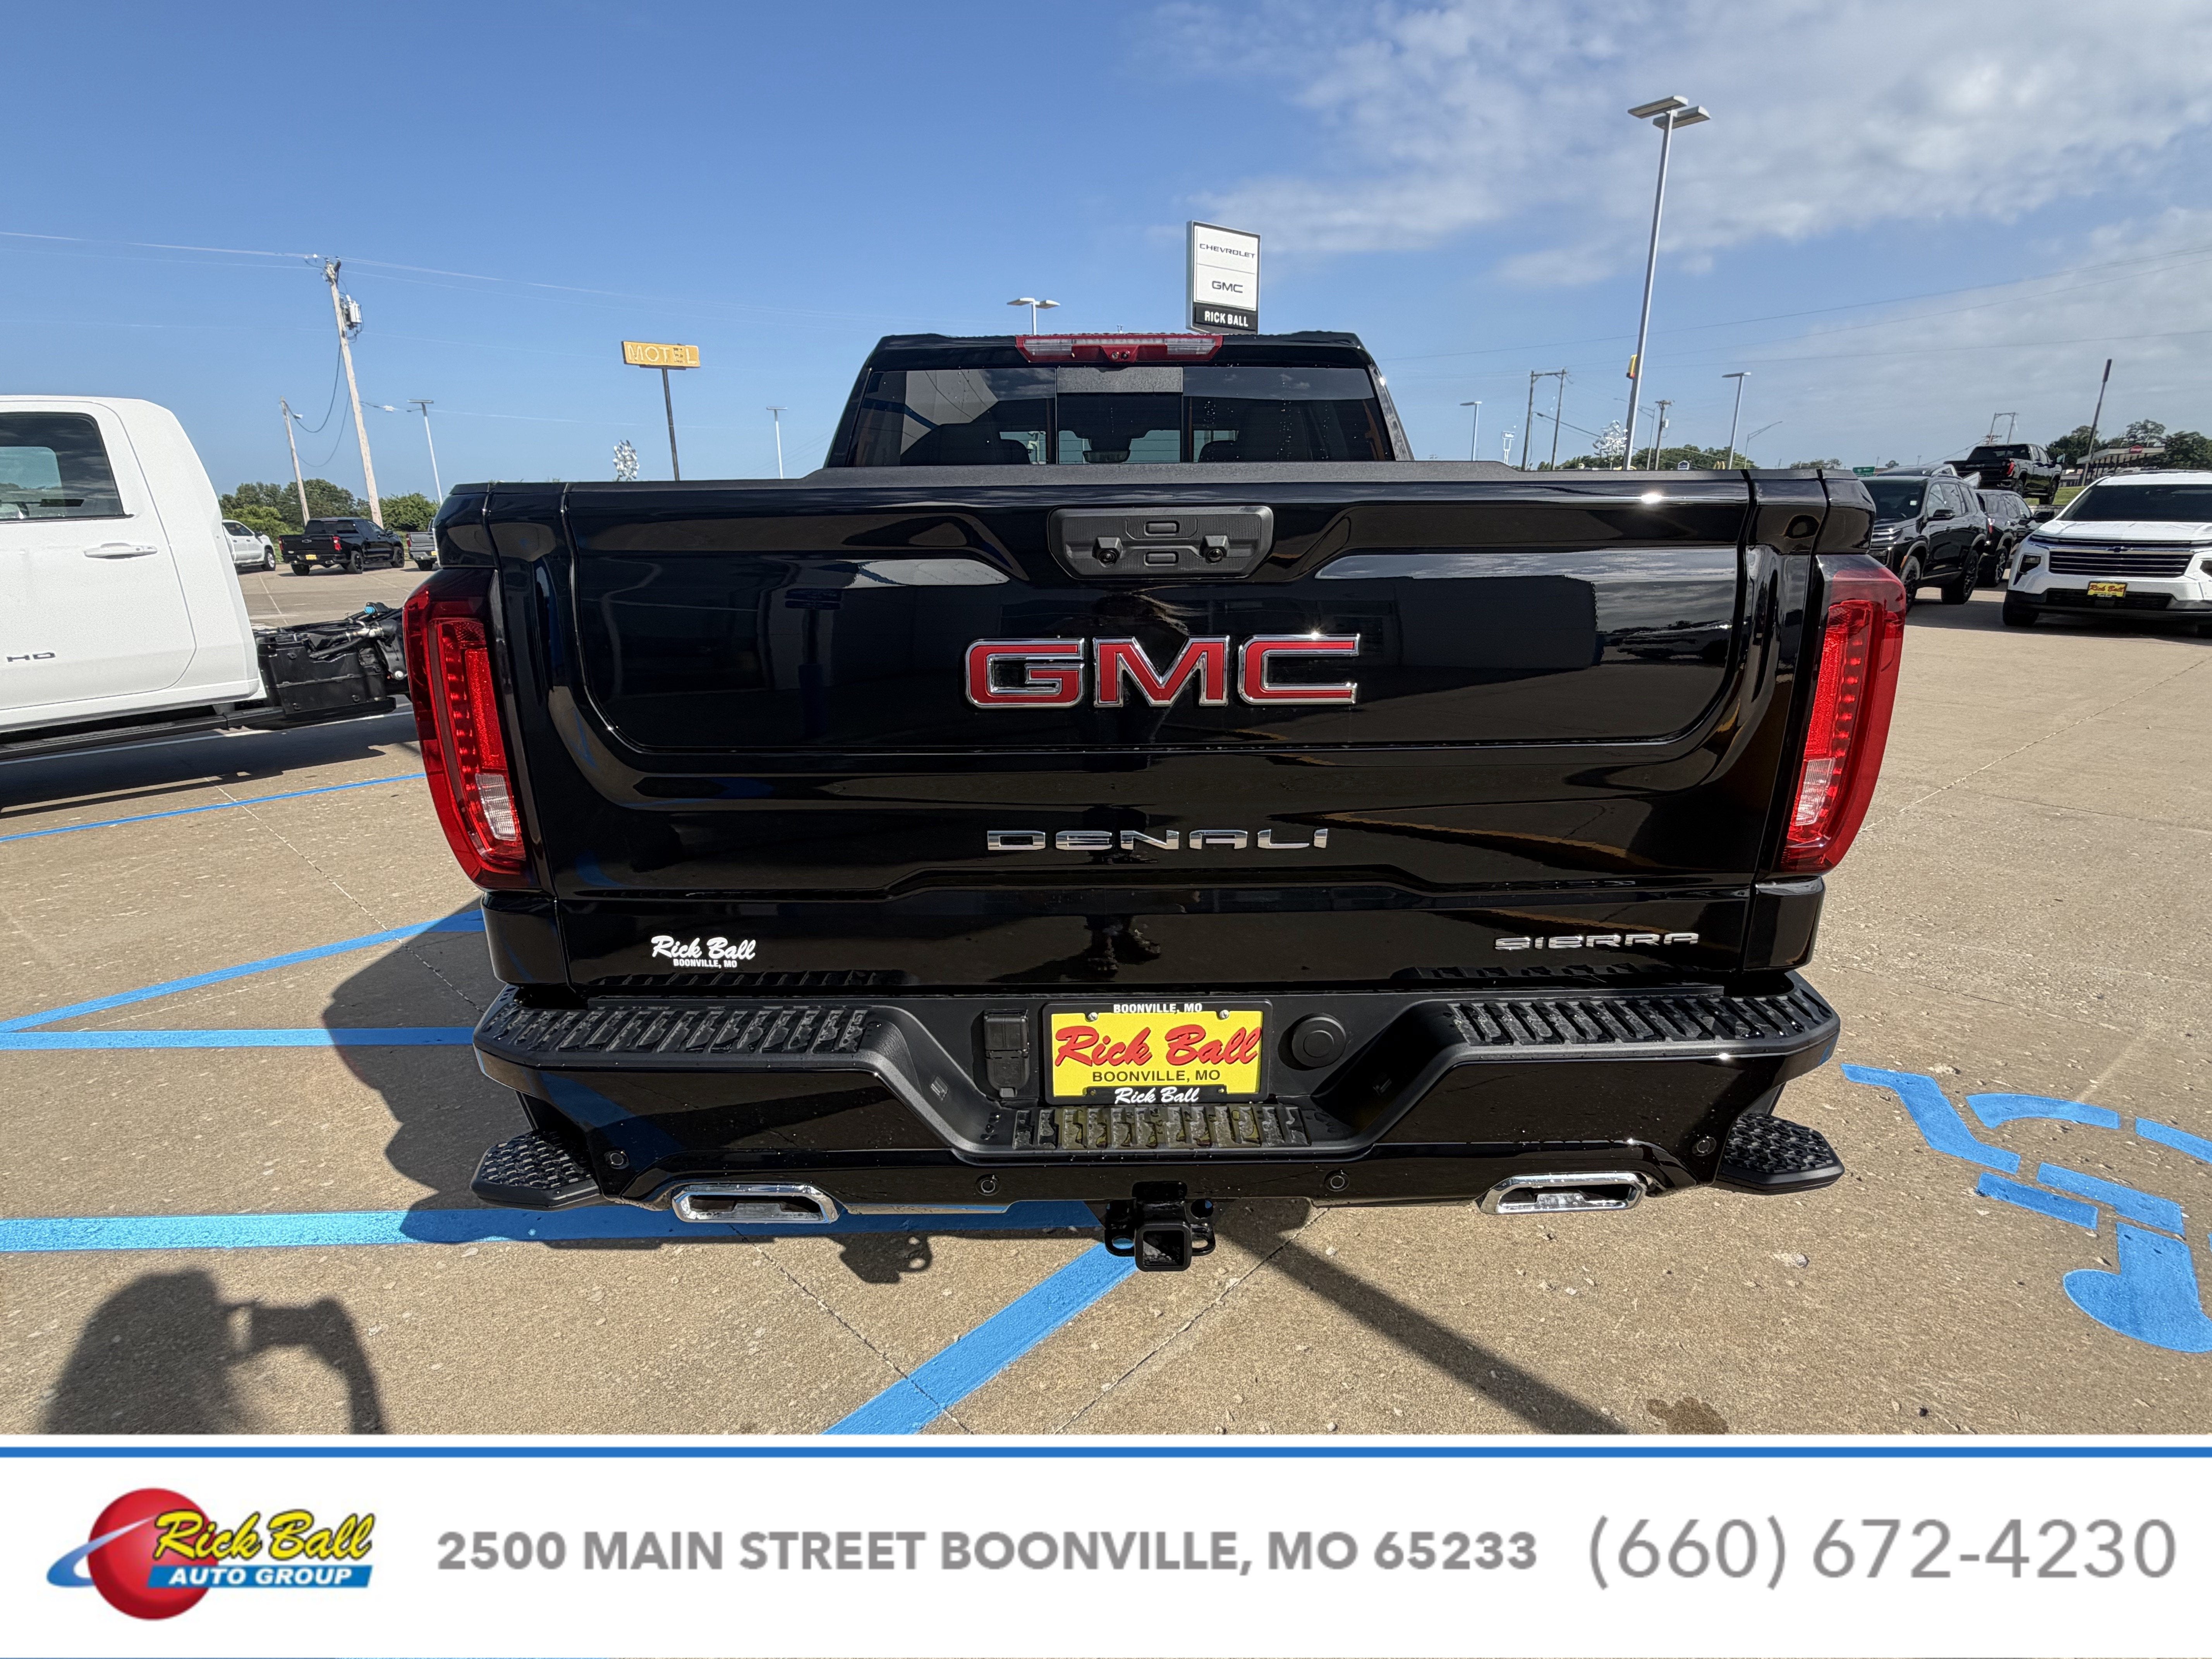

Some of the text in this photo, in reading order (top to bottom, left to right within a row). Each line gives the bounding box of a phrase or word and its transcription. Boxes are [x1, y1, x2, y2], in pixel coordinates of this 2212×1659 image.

[1200, 244, 1255, 258] CHEVROLET
[1212, 281, 1243, 293] GMC
[1204, 311, 1249, 327] RICK BALL
[627, 344, 698, 364] MOTEL
[7, 652, 55, 662] HD
[964, 634, 1360, 709] GMC
[987, 828, 1328, 850] DENALI
[651, 935, 756, 960] Rick Ball
[1495, 933, 1699, 950] SIERRA
[673, 959, 722, 969] BOONVILLE,
[1113, 1003, 1203, 1014] BOONVILLE, MO
[1054, 1025, 1262, 1067] Rick Ball
[1092, 1070, 1220, 1082] BOONVILLE, MO
[1114, 1087, 1199, 1104] Rick Ball
